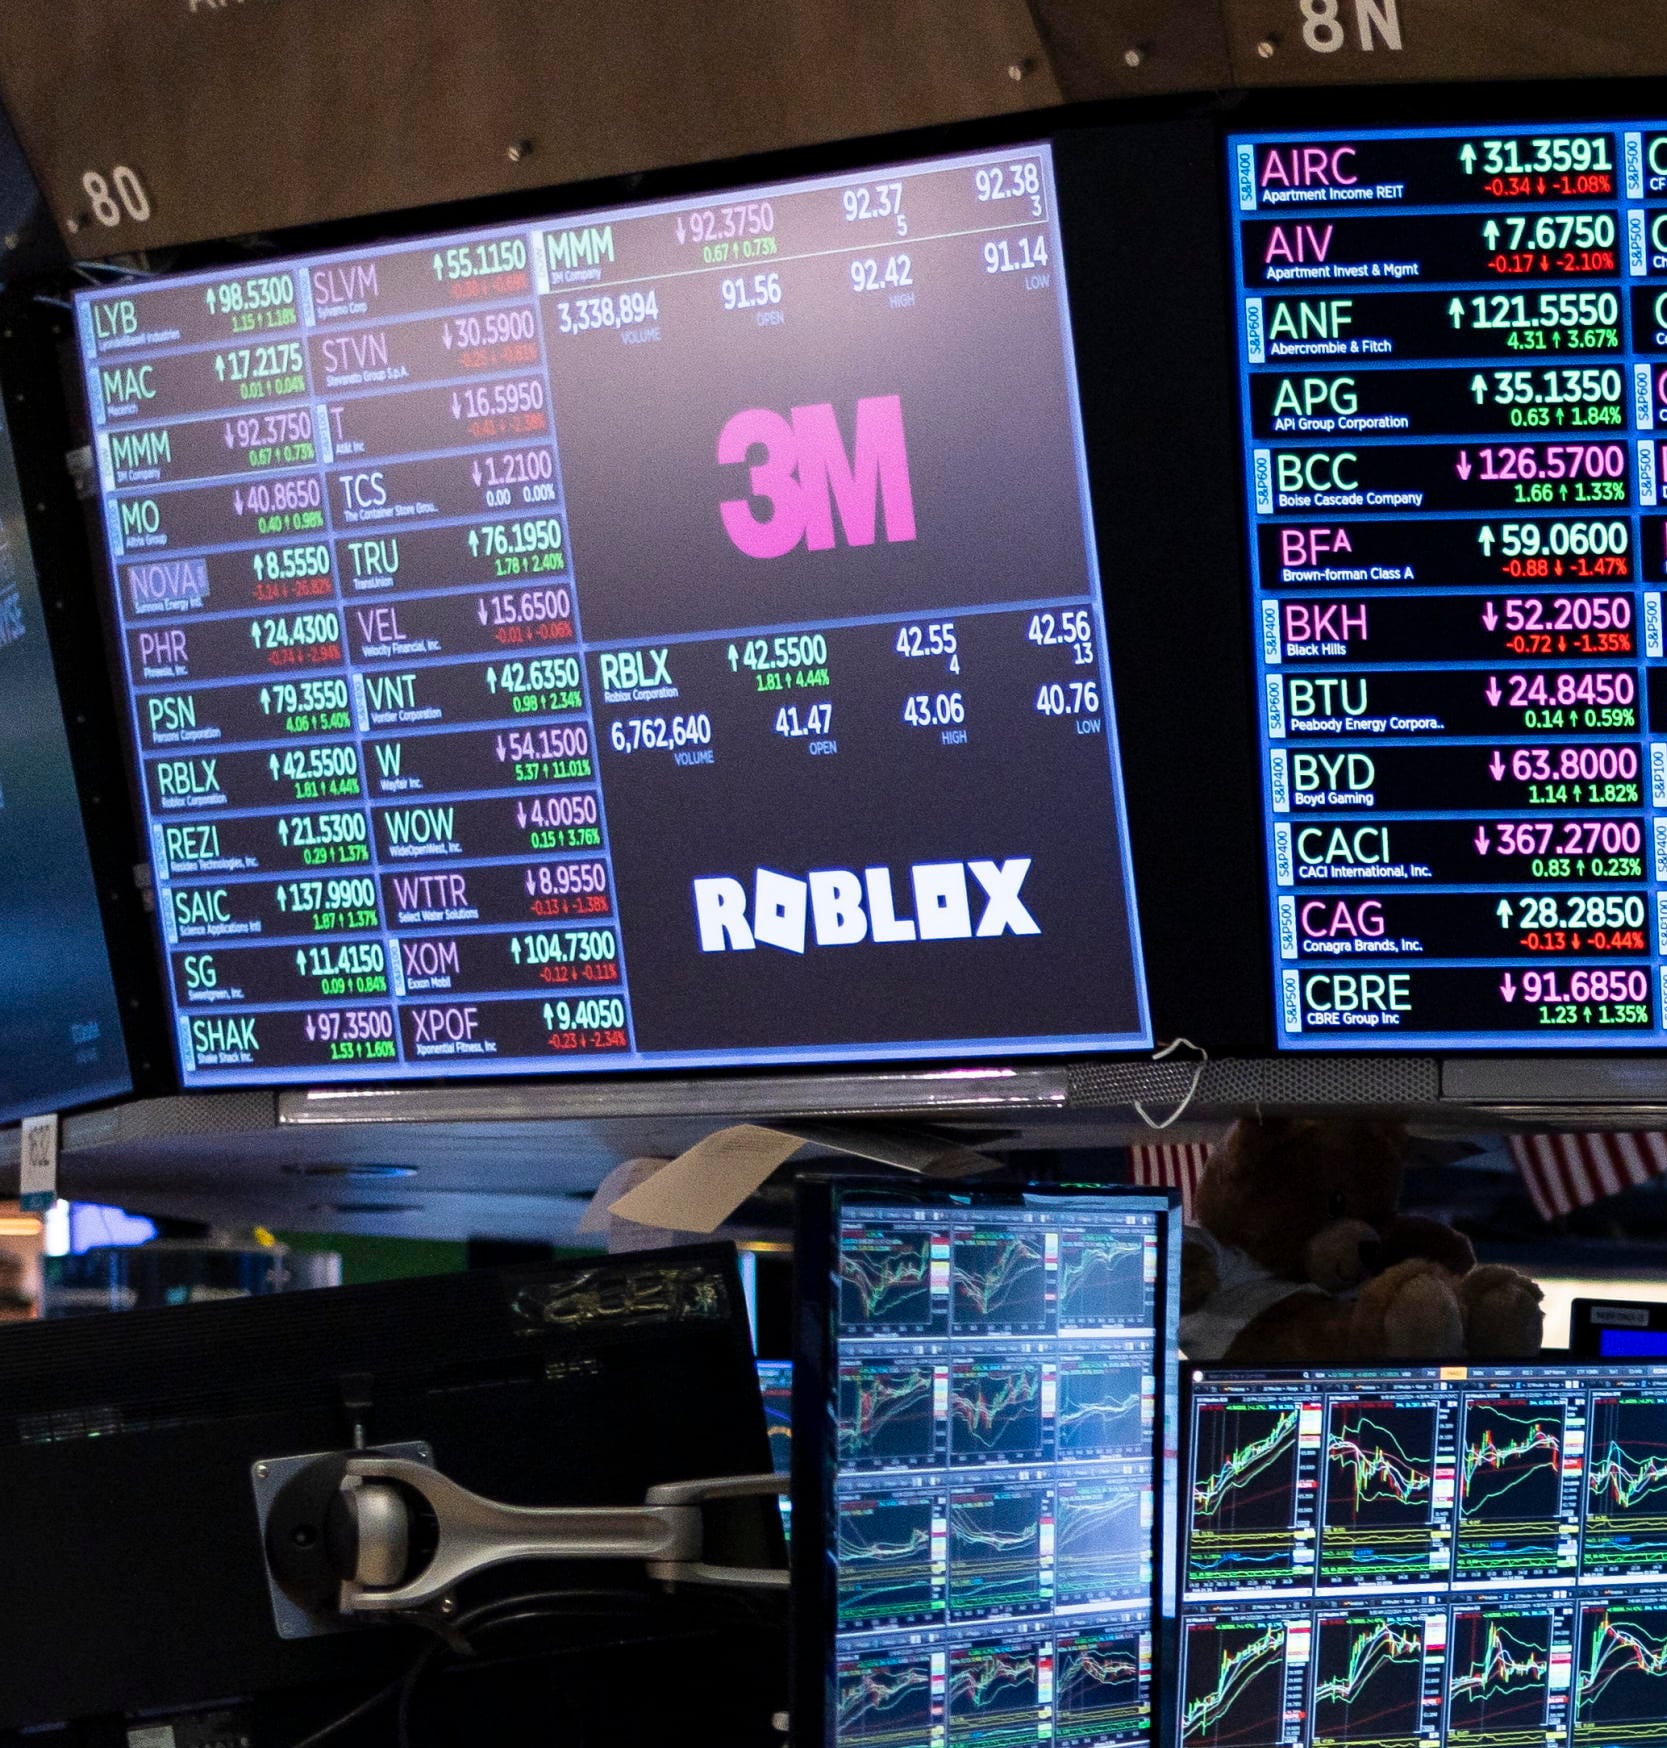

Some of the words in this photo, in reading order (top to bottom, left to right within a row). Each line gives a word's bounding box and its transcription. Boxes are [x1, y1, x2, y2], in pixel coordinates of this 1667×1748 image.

[1262, 147, 1357, 186] AIRC
[1483, 138, 1612, 174] 31.3591
[842, 183, 904, 222] 92.37
[975, 163, 1041, 208] 92.38
[1263, 189, 1326, 204] Apartment
[1330, 188, 1373, 200] Income
[1377, 185, 1403, 198] REIT
[1485, 177, 1531, 196] -0.34
[1553, 175, 1611, 194] -1.08%
[690, 203, 775, 247] 92.3750
[447, 240, 527, 280] 55.1150
[548, 226, 614, 270] MMM
[984, 236, 1048, 279] 91.14
[219, 271, 293, 313] 98.5300
[314, 264, 379, 304] SLVM
[722, 271, 782, 312] 91.56
[850, 253, 912, 294] 92.42
[94, 298, 139, 341] LYB
[557, 290, 659, 336] 3,338,894
[1269, 301, 1352, 339] ANF
[1472, 293, 1618, 328] 121.5550
[104, 365, 156, 404] MAC
[112, 431, 170, 469] MMM
[716, 393, 916, 558] 3M
[348, 539, 398, 575] TRU
[140, 630, 188, 664] PHR
[1029, 611, 1093, 655] 42.56
[600, 649, 672, 690] RBLX
[740, 636, 828, 678] 42.5500
[1037, 681, 1099, 715] 40.76
[612, 714, 710, 753] 6,762,640
[167, 826, 219, 860] REZI
[385, 808, 453, 844] WOW
[1497, 822, 1640, 855] 367.2700
[1298, 827, 1389, 864] CACI
[176, 890, 230, 924] SAIC
[694, 859, 1041, 954] ROBLOX
[403, 942, 459, 975] XOM
[524, 931, 615, 963] 104.7300
[1306, 975, 1411, 1011] CBRE
[1523, 971, 1647, 1002] 91.6850
[193, 1018, 259, 1052] SHAK
[318, 1011, 392, 1040] 97.3500
